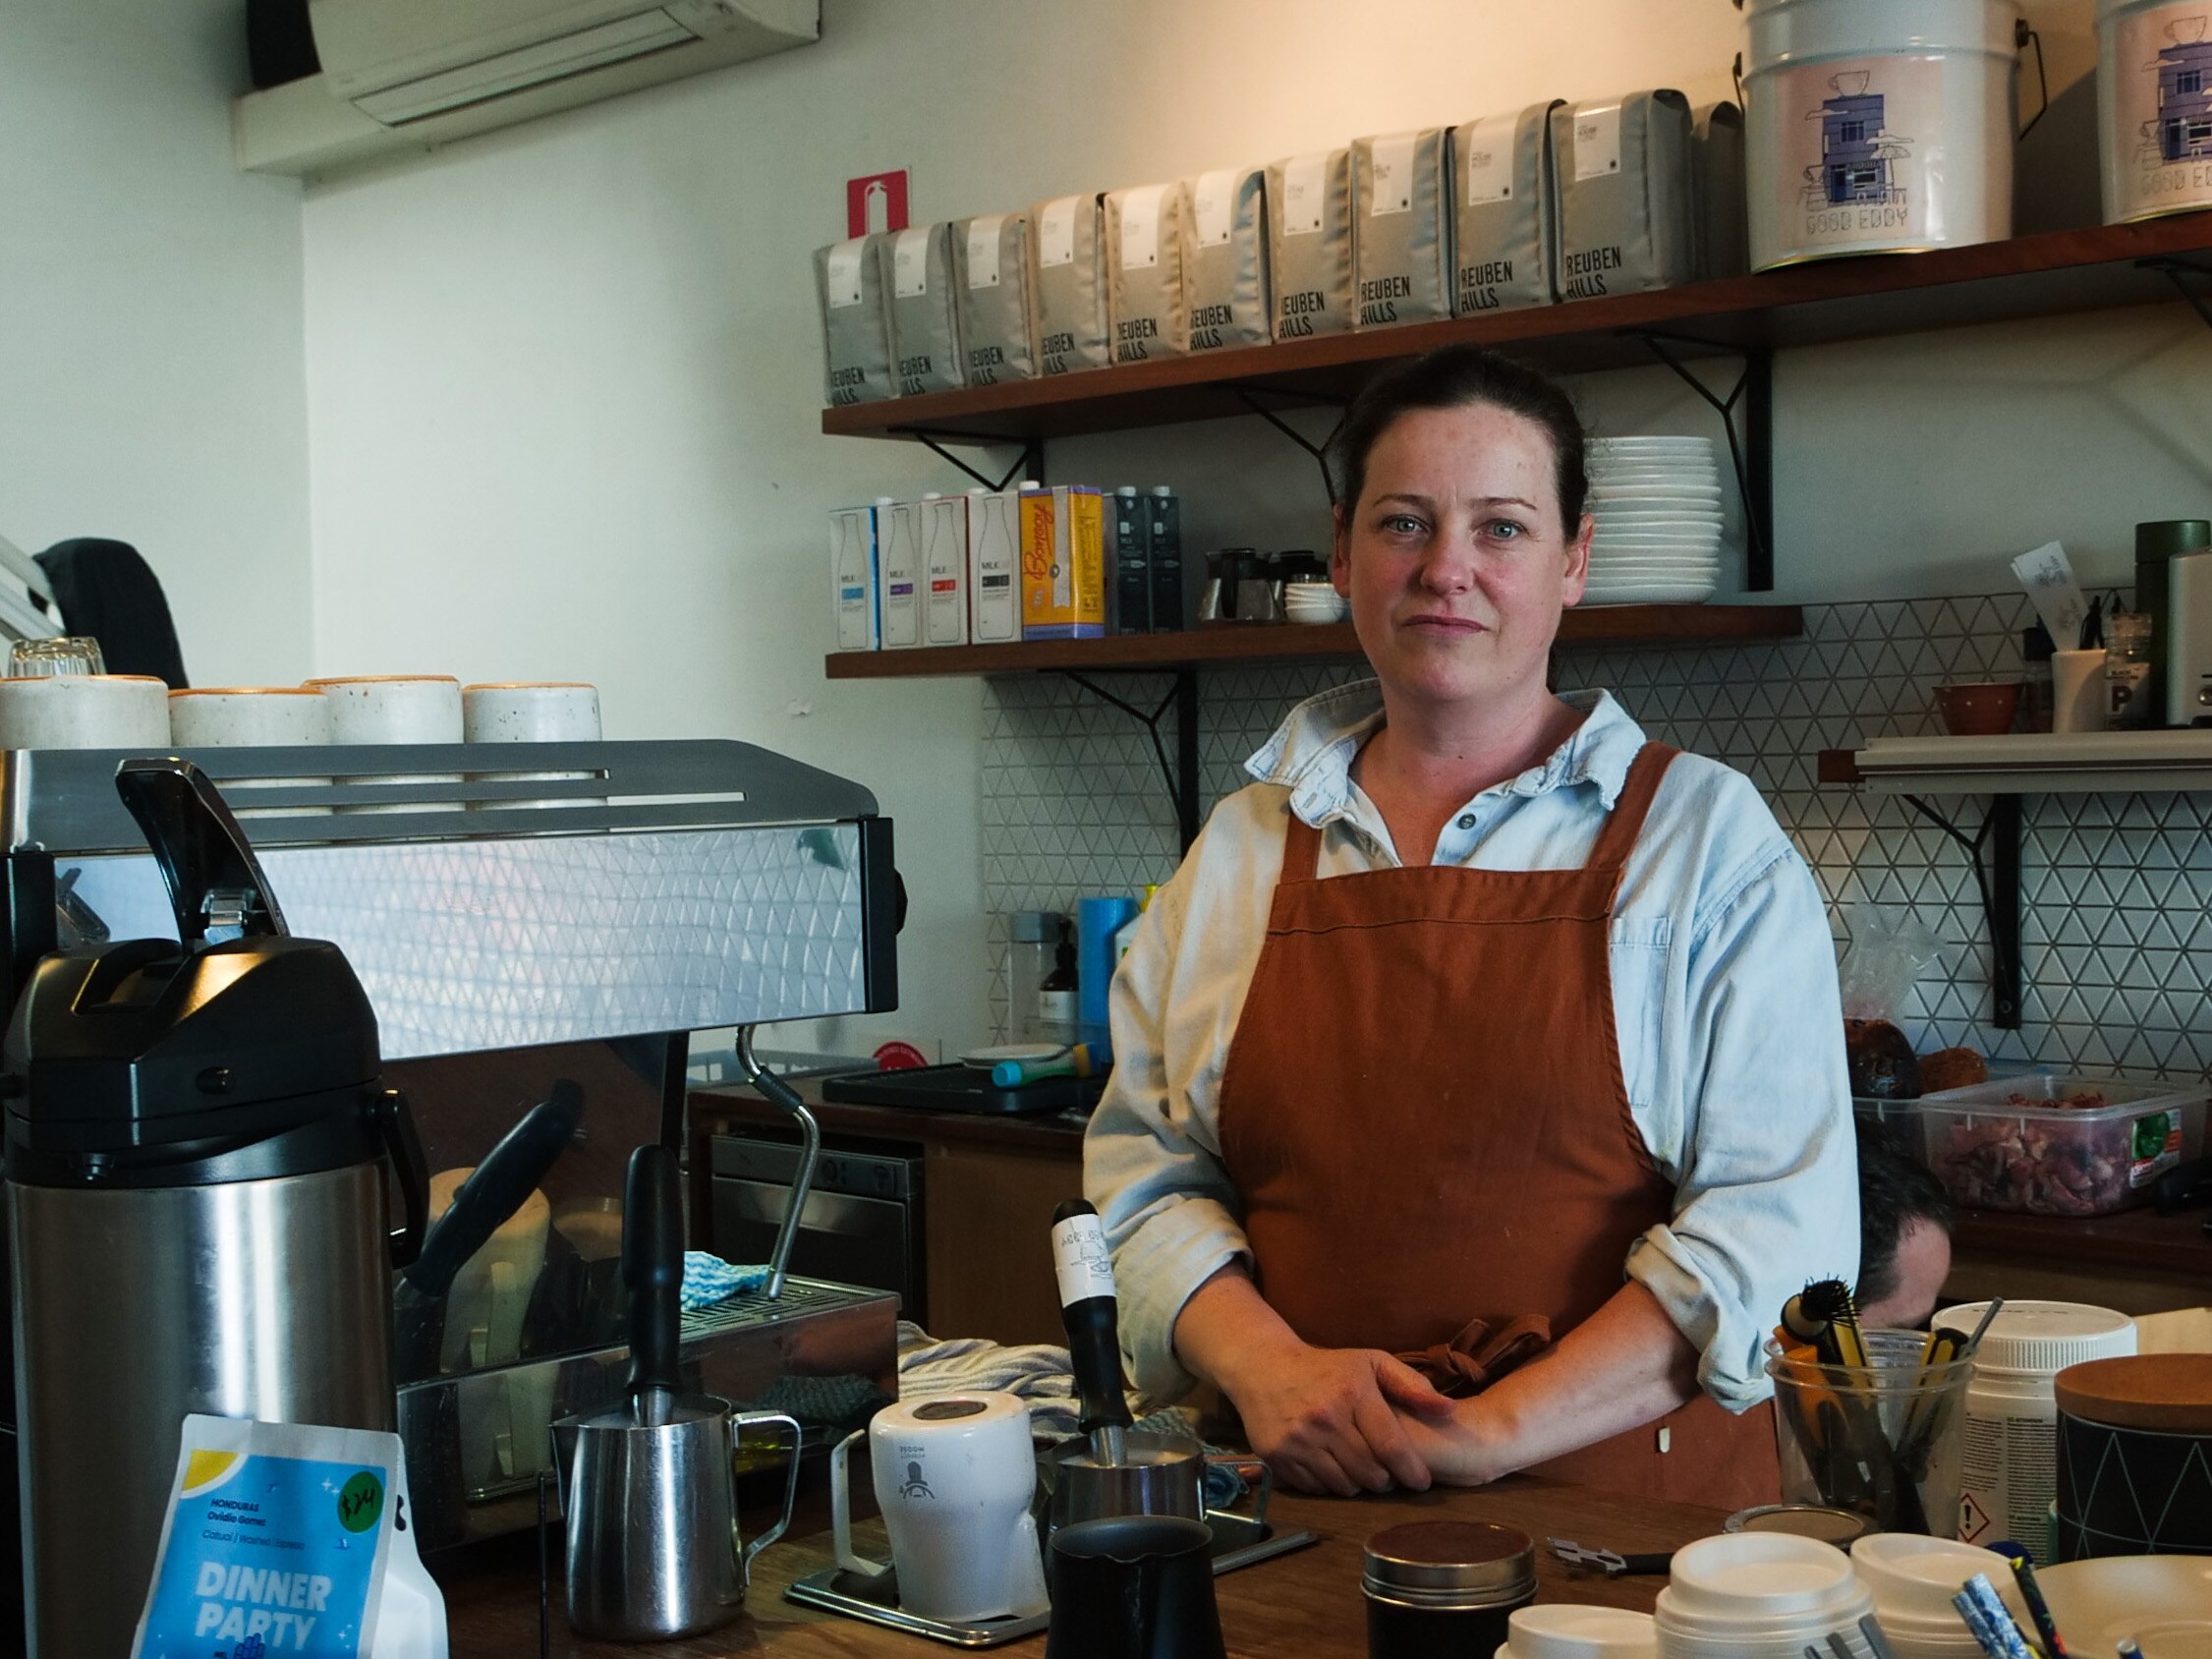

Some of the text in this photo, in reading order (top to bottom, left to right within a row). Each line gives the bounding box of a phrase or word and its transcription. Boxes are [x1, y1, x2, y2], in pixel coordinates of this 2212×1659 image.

[1807, 207, 1908, 235] GOOD EDDY
[1565, 246, 1622, 278] REUBEN
[1565, 274, 1609, 300] HILLS
[1461, 287, 1500, 314] HILLS
[1042, 332, 1076, 355] EUBEN
[832, 367, 866, 387] EUBEN
[899, 356, 934, 377] EUBEN
[207, 1511, 237, 1523] Ovidio
[210, 1498, 260, 1513] HONDURAS
[195, 1560, 332, 1613] DINNER
[194, 1601, 316, 1651] PARTY
